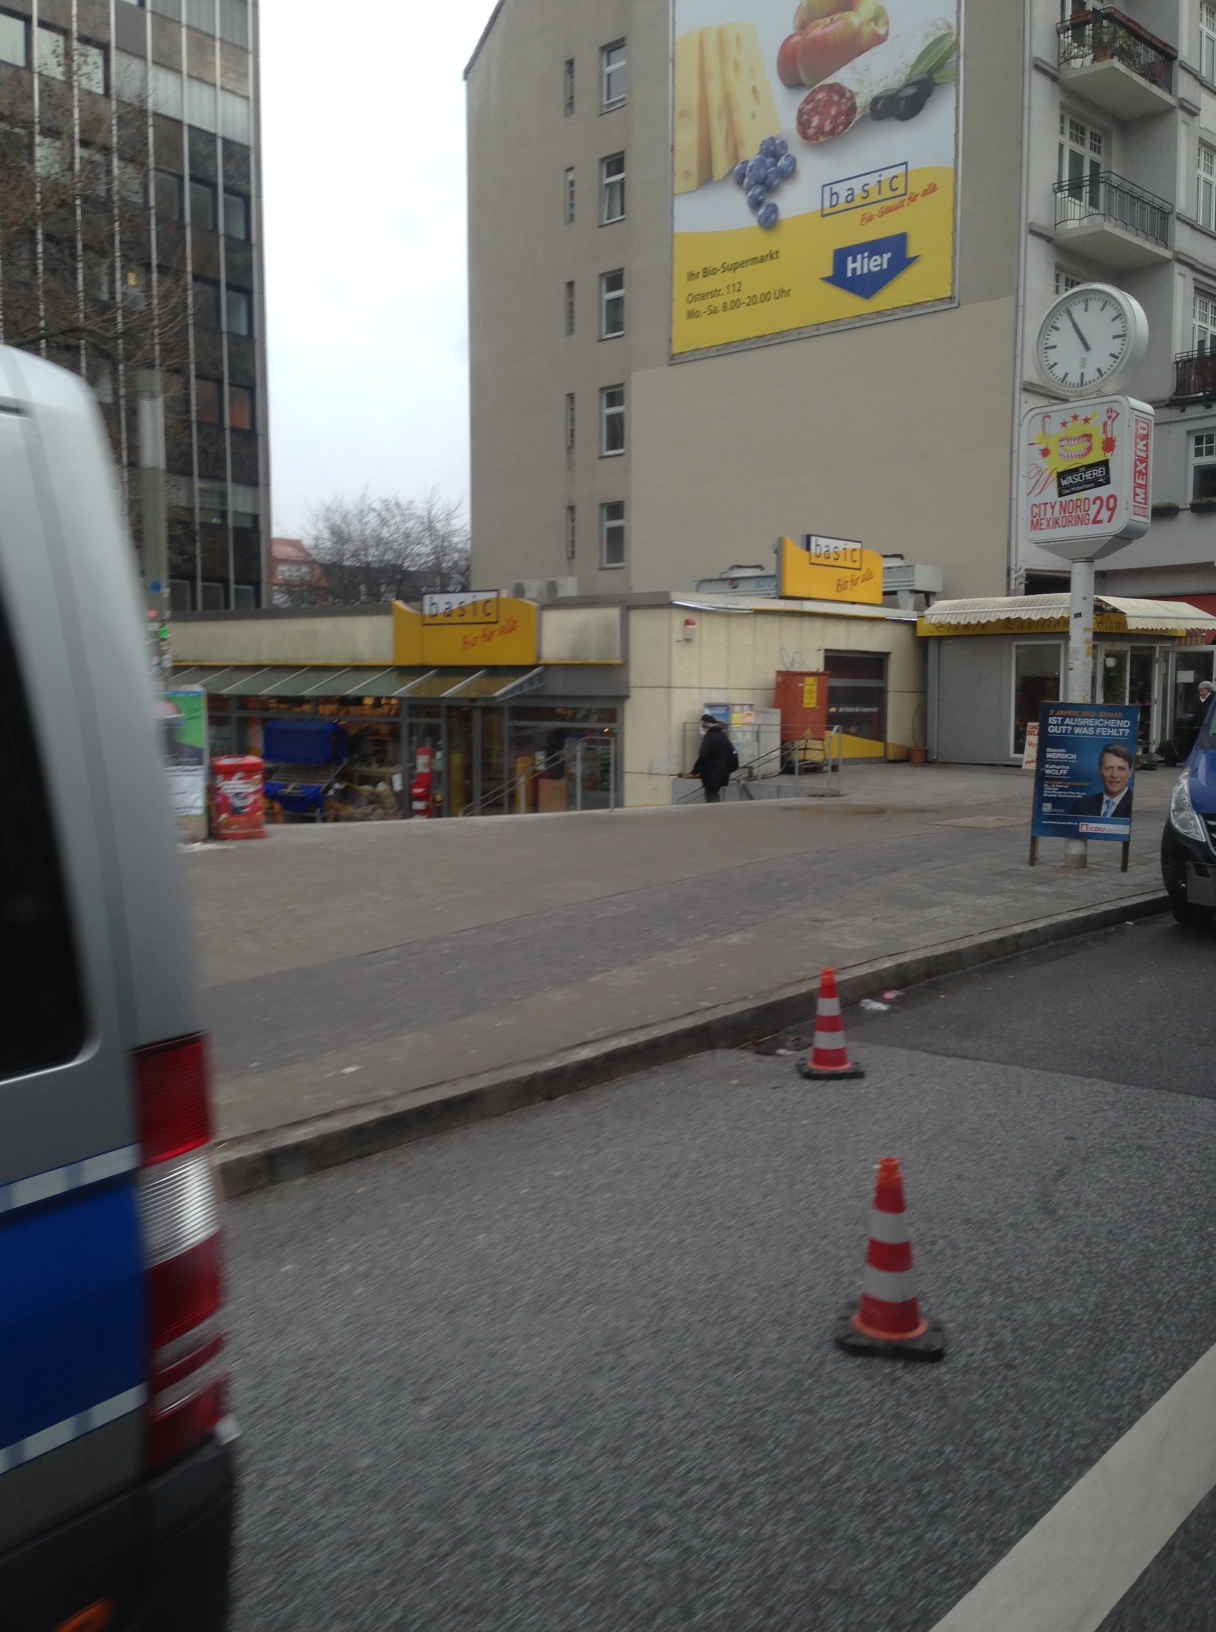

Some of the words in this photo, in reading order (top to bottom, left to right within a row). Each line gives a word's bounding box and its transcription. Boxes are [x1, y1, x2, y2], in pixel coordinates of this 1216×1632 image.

[829, 174, 899, 208] basic
[687, 270, 700, 282] Ihr
[702, 249, 780, 278] Bio-Supermarkt
[846, 251, 892, 278] Hier
[686, 288, 724, 304] Osterstr.
[726, 281, 743, 295] 112
[774, 287, 791, 300] Uhr
[1133, 420, 1150, 506] MEXIKO
[1030, 501, 1057, 519] CITY
[1059, 497, 1090, 516] NORD
[1091, 494, 1118, 525] 29
[1030, 512, 1090, 531] MEXIKORING
[815, 537, 857, 563] basic
[428, 593, 493, 618] basic
[1048, 716, 1064, 724] IST
[1064, 717, 1130, 728] AUSREICHEND
[1048, 726, 1072, 734] GUT?
[1073, 727, 1094, 735] WAS
[1096, 728, 1130, 737] FEHLT?
